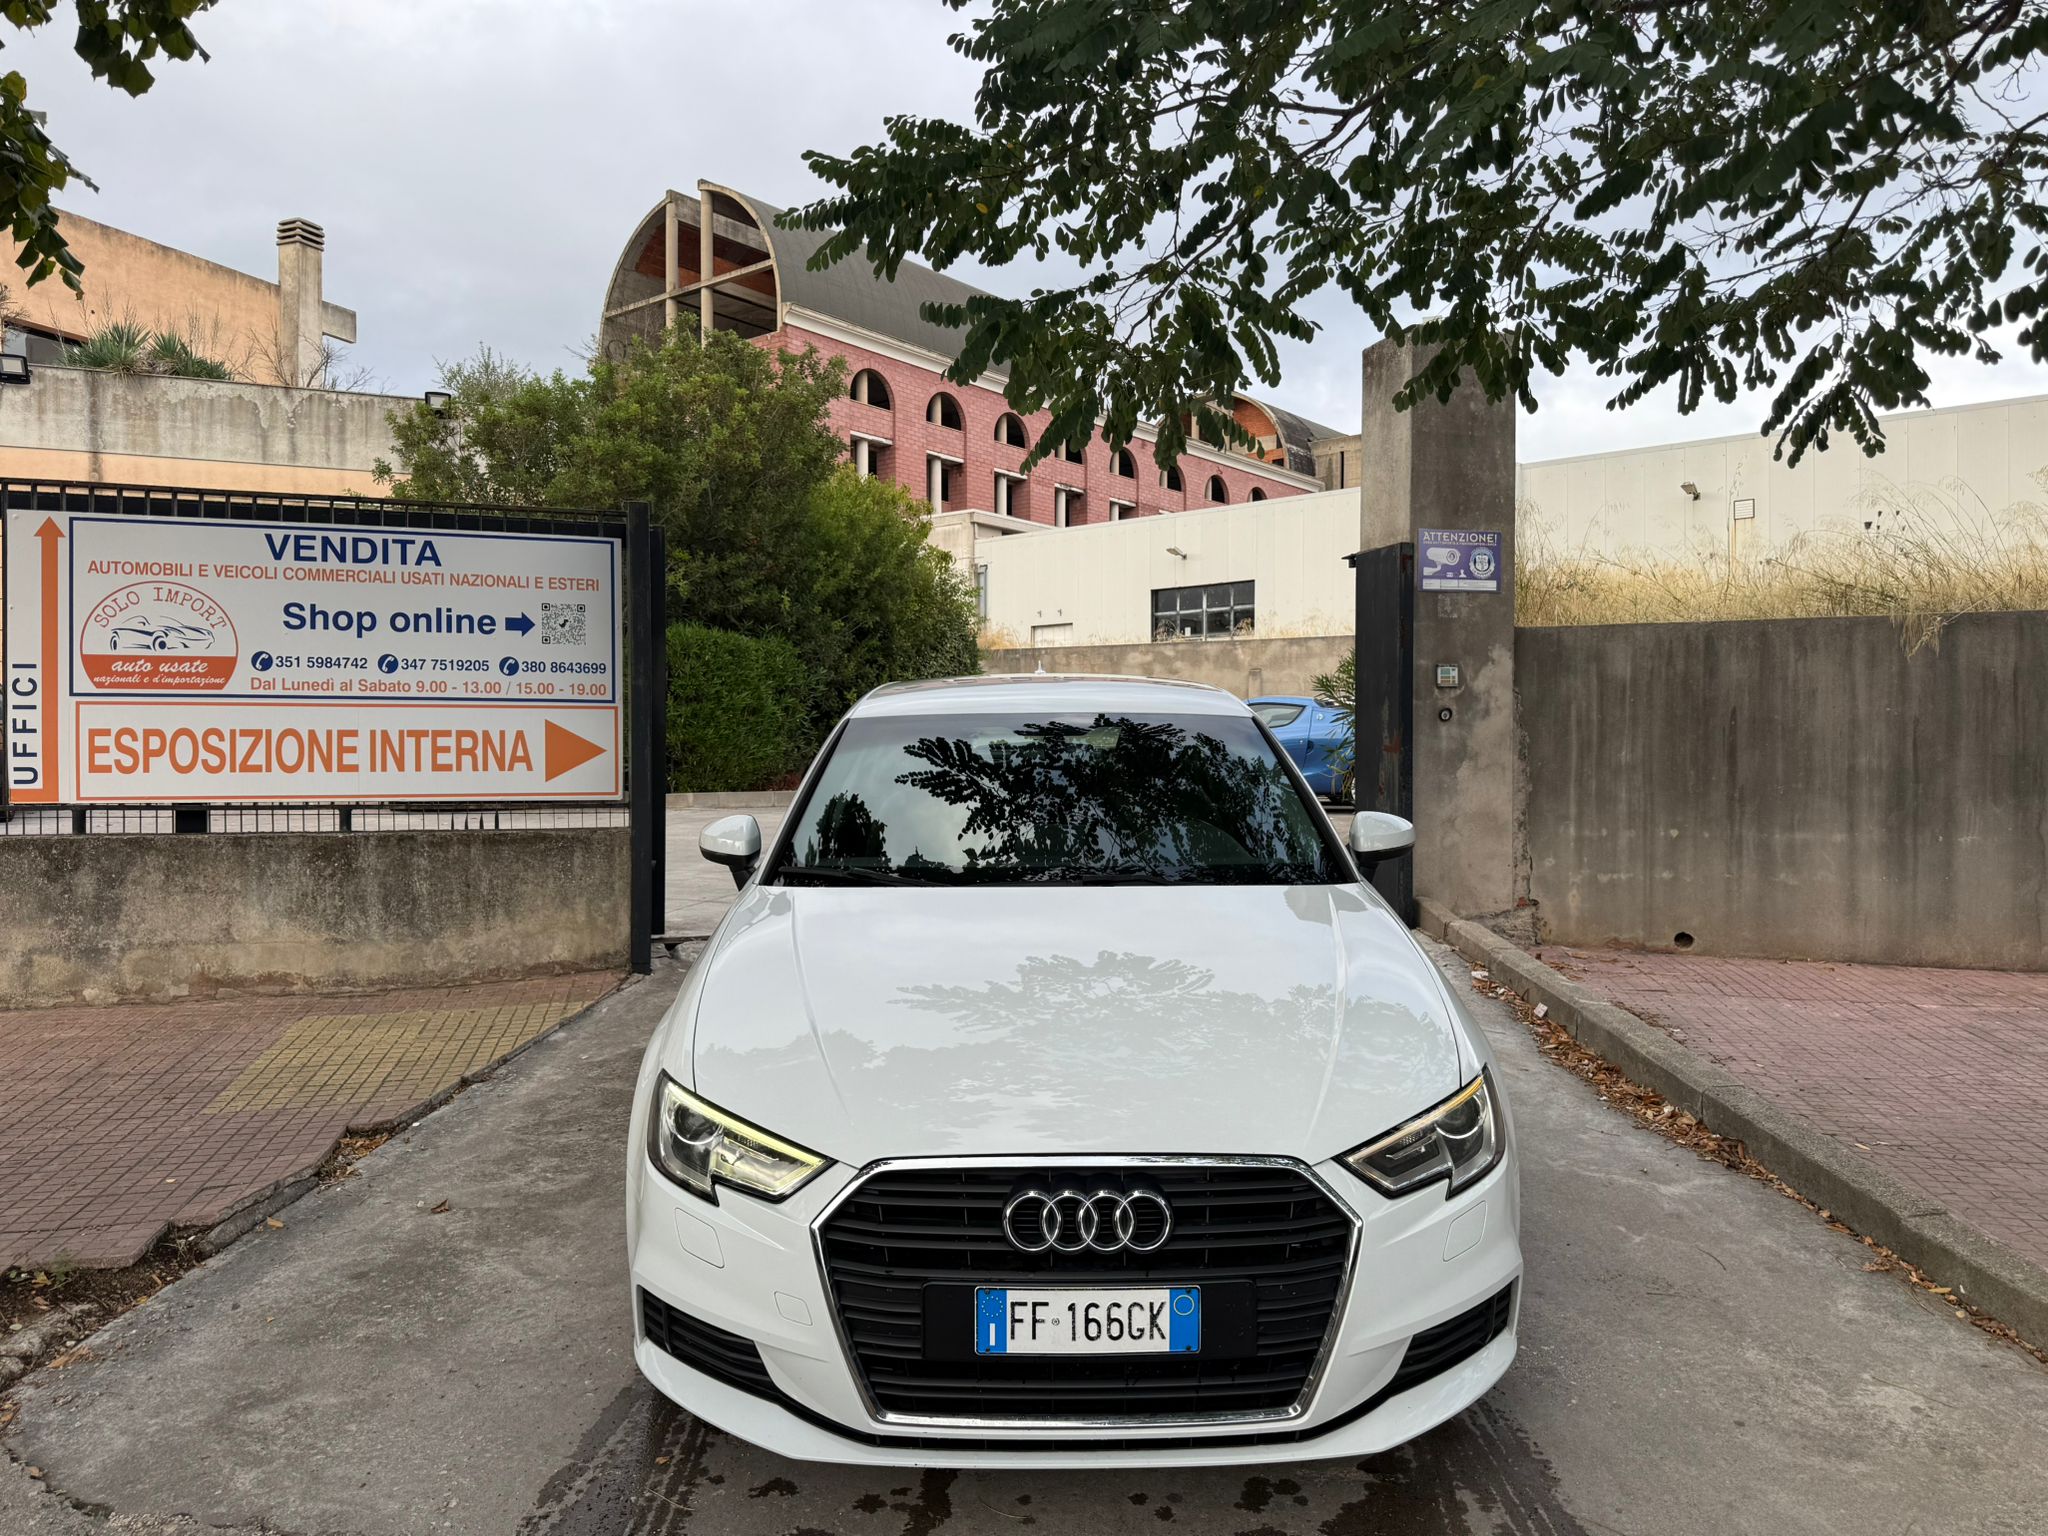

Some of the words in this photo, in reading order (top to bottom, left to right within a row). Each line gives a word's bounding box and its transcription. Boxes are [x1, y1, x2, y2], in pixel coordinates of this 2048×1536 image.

[264, 533, 442, 567] VENDITA
[1423, 531, 1498, 546] ATTENZIONE!
[87, 559, 193, 577] AUTOMOBILI
[198, 563, 209, 578] E
[213, 564, 278, 580] VEICOLI
[283, 566, 396, 584] COMMERCIALI
[401, 571, 445, 586] USATI
[450, 573, 530, 589] NAZIONALI
[534, 576, 544, 590] E
[548, 577, 600, 592] ESTERI
[94, 590, 140, 628] SOLO
[153, 586, 228, 630] IMPORT
[283, 602, 377, 639] Shop
[389, 607, 497, 636] online
[111, 658, 153, 673] auto
[159, 660, 209, 673] usate
[275, 656, 301, 668] 351
[306, 656, 368, 670] 5984742
[400, 658, 427, 670] 347
[431, 659, 490, 672] 7519205
[521, 661, 546, 673] 380
[550, 662, 607, 674] 8643699
[93, 674, 141, 686] nazionali
[152, 673, 225, 685] d'importazione
[250, 677, 276, 691] Dal
[281, 677, 335, 692] Lunedì
[339, 679, 353, 691] al
[358, 678, 411, 693] Sabato
[416, 680, 447, 693] 9.00
[463, 681, 501, 694] 13.00
[505, 681, 511, 695] /
[516, 682, 555, 695] 15.00
[569, 683, 607, 696] 19.00
[11, 663, 39, 785] UFFICI
[87, 726, 360, 775] ESPOSIZIONE
[369, 729, 534, 773] INTERNA
[1009, 1301, 1050, 1341] FF
[1067, 1301, 1167, 1342] 166GK
